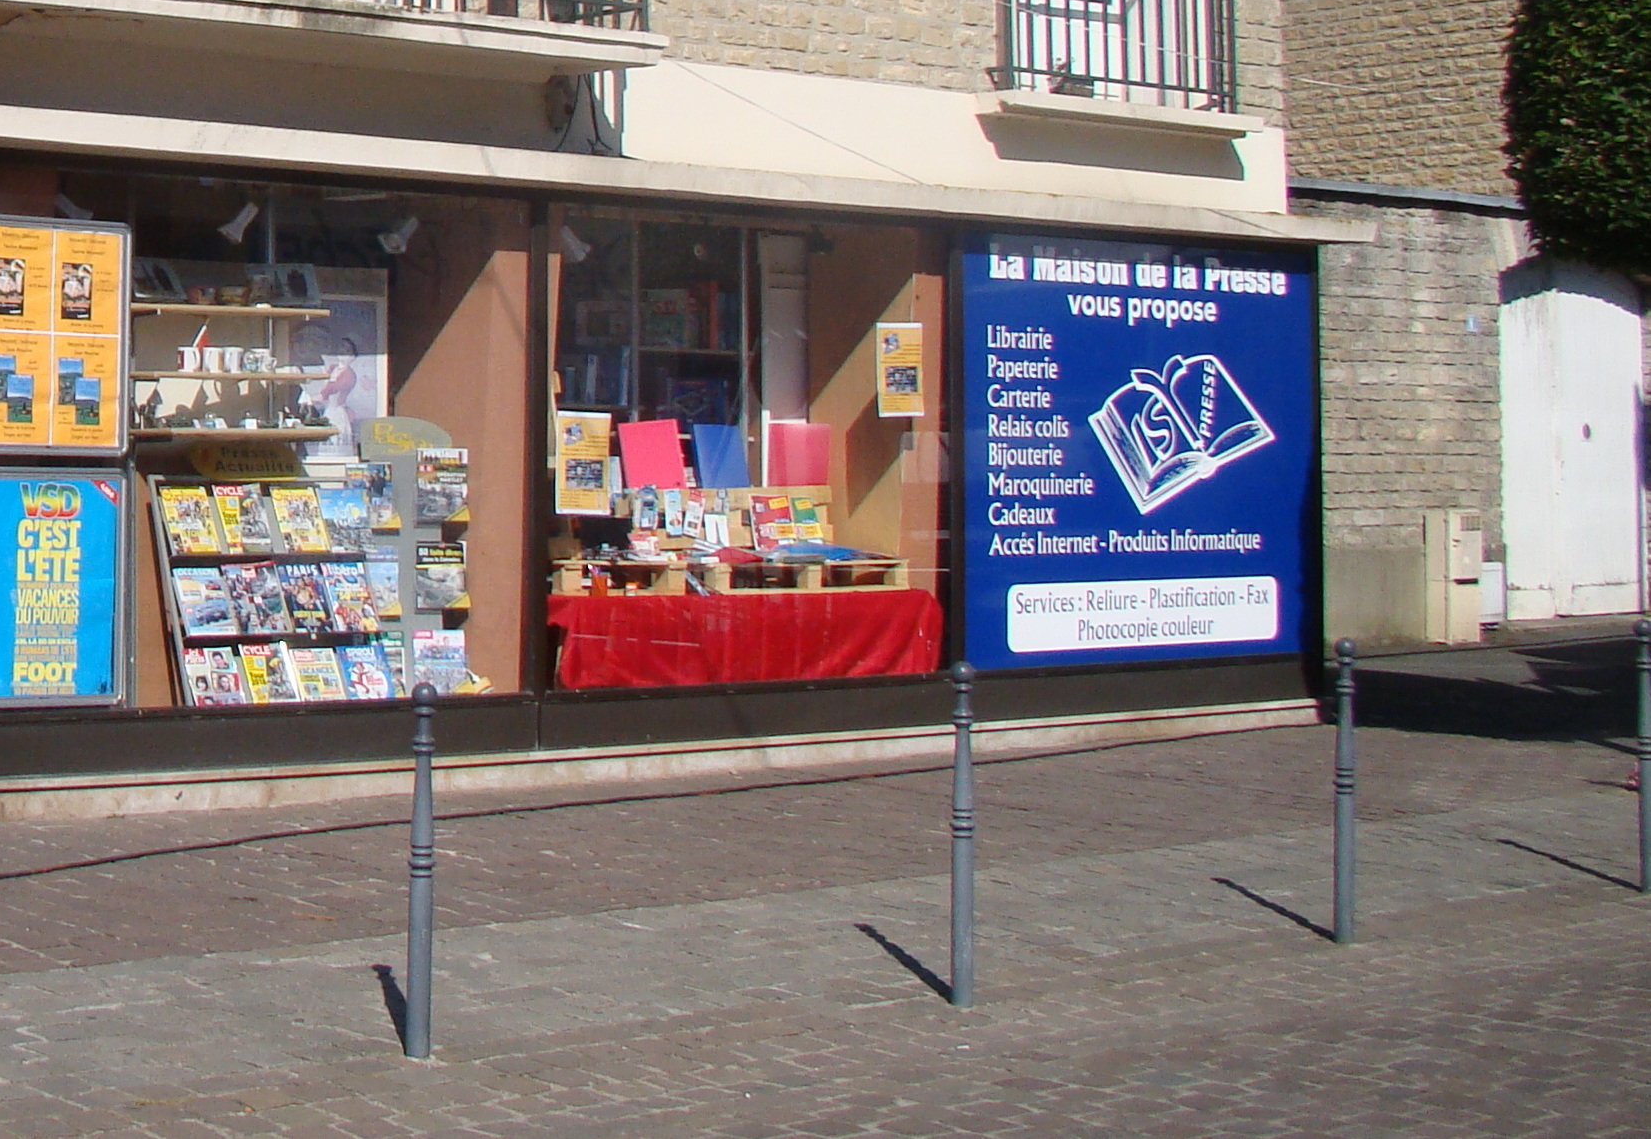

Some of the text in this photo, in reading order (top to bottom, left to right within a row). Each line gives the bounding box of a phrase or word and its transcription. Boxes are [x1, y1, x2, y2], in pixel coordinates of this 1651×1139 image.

[989, 242, 1287, 295] La Maison de la Presse
[1067, 294, 1218, 327] vous propose
[987, 324, 1053, 350] Librairie
[987, 354, 1059, 382] Papeterie
[987, 384, 1051, 409] Carterie
[1199, 361, 1217, 438] PRESSE
[988, 414, 1069, 438] Relais colis
[988, 443, 1063, 469] Bijouterie
[216, 486, 244, 496] CYCLE
[988, 472, 1094, 500] Maroquinerie
[20, 482, 81, 519] VSD
[988, 502, 1056, 526] Cadeaux
[18, 519, 81, 550] C'EST
[1037, 532, 1098, 554] Internet
[1108, 530, 1169, 552] Produits
[1171, 529, 1261, 554] Informatique
[286, 565, 318, 576] PARIS
[17, 589, 79, 608] VACANCES
[1016, 592, 1074, 614] Services
[1086, 590, 1138, 611] Reliure
[1149, 585, 1236, 609] Plastification
[1247, 584, 1269, 605] Fax
[16, 607, 79, 624] DU POUVOIR
[1077, 615, 1215, 642] Photocopie couleur
[243, 646, 271, 655] CYCLE
[13, 662, 77, 683] FOOT
